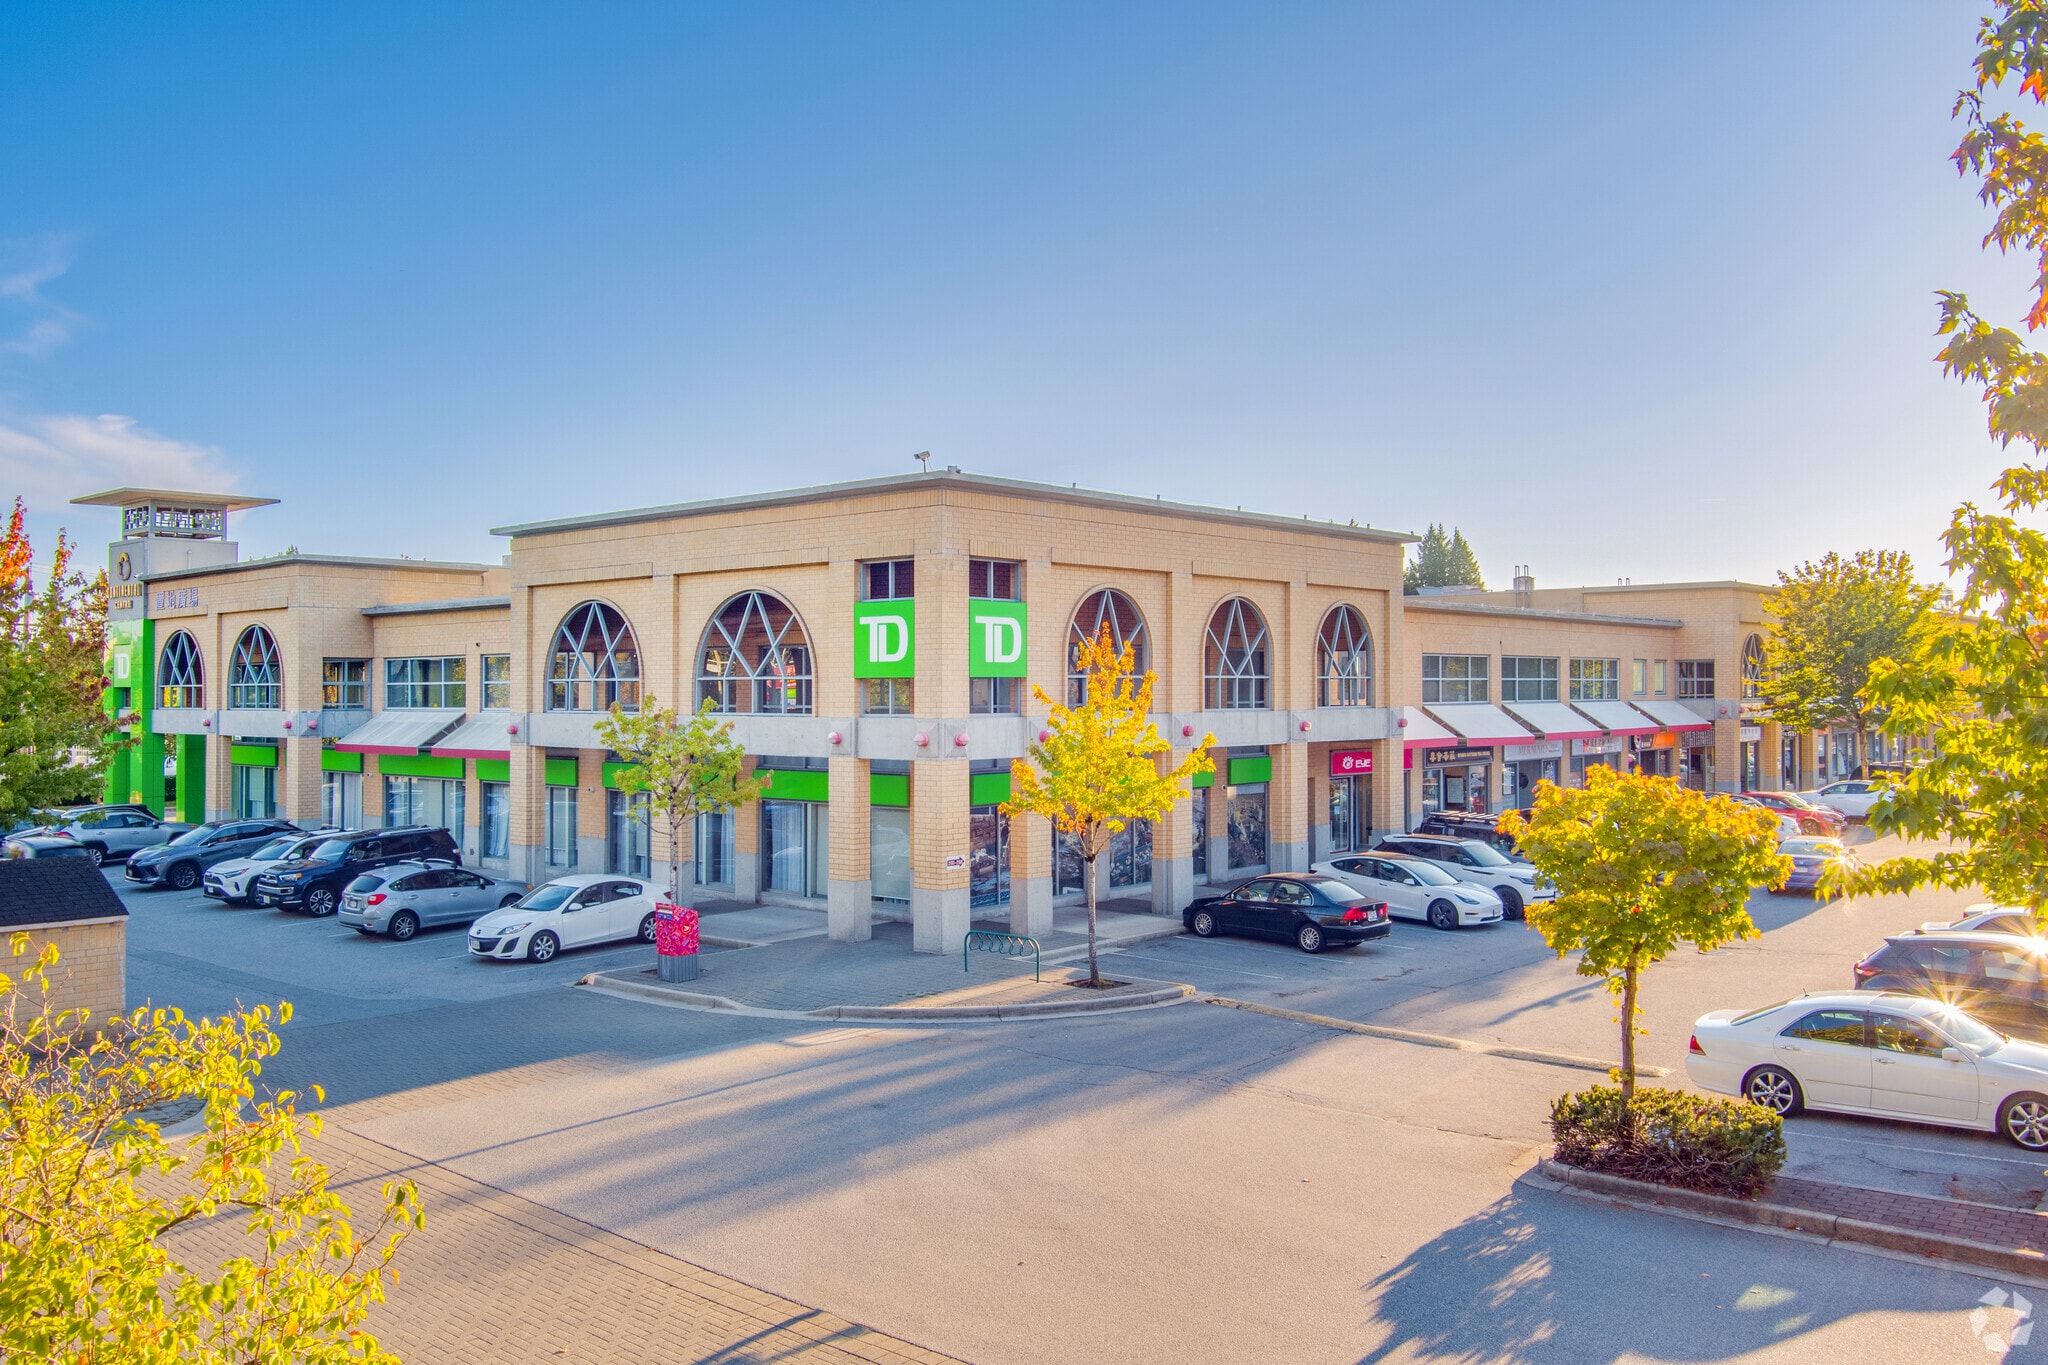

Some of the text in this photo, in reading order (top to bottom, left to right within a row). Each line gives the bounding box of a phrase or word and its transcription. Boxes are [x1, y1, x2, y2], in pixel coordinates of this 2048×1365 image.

[859, 615, 909, 663] TD
[975, 615, 1022, 663] TD
[114, 653, 130, 679] TD
[1355, 759, 1371, 769] EYE
